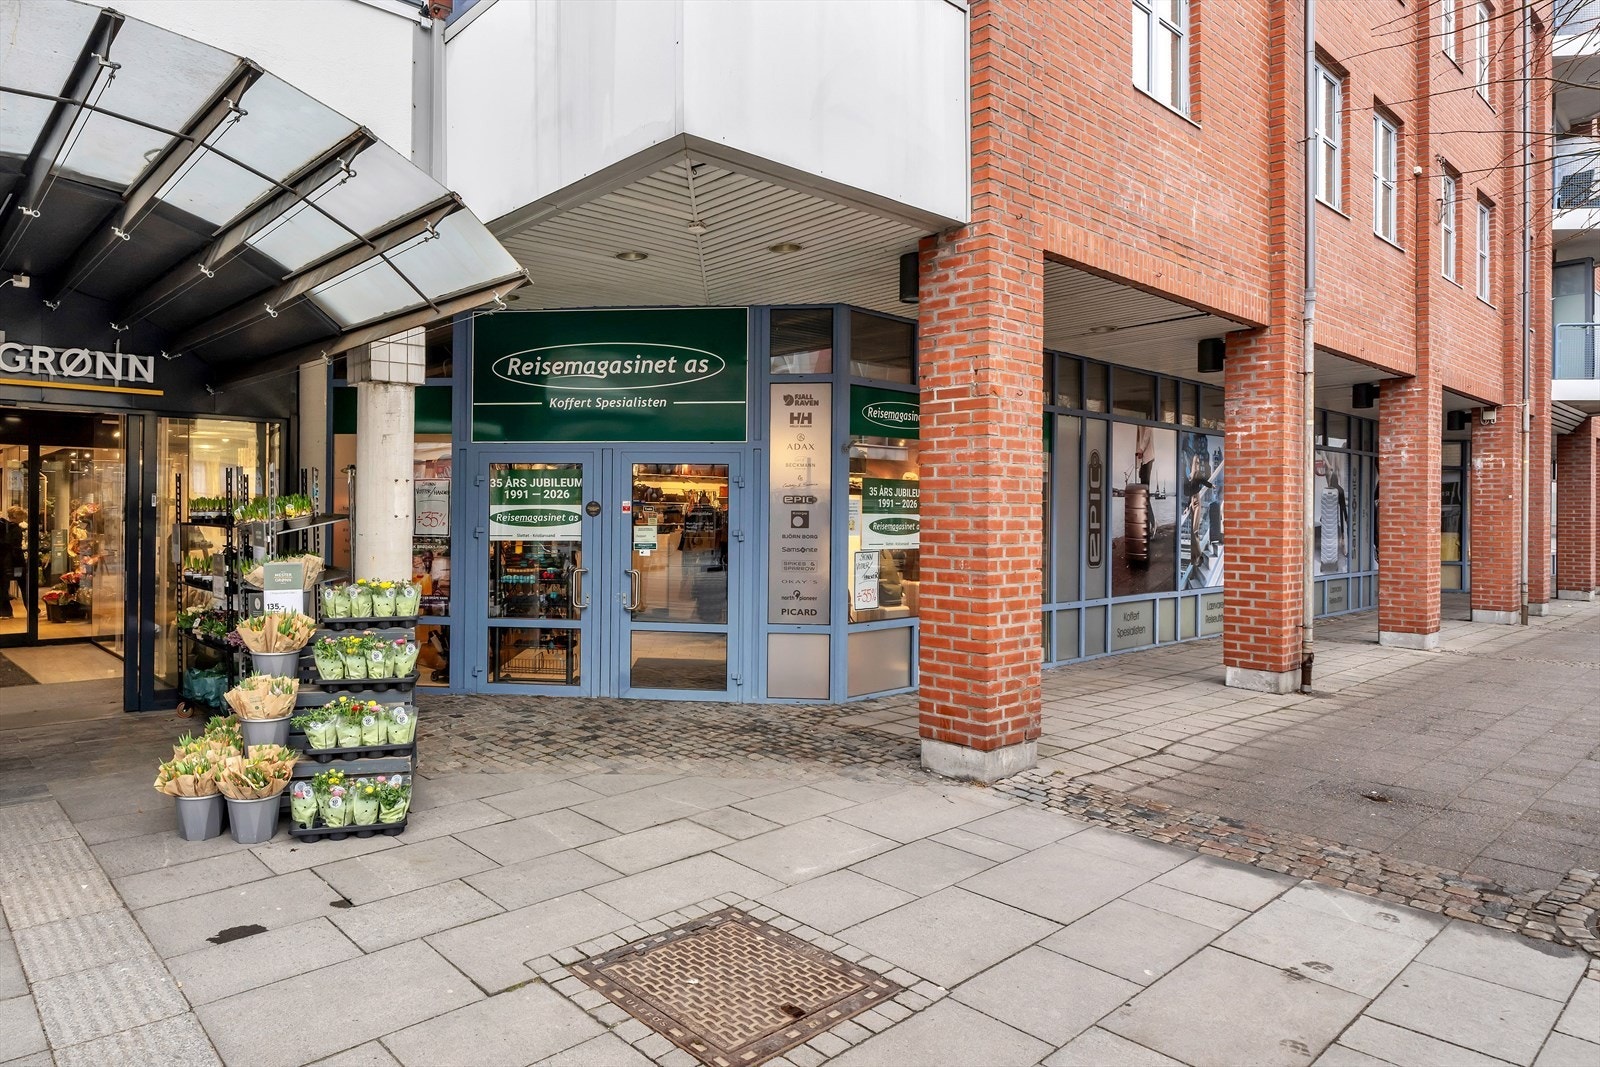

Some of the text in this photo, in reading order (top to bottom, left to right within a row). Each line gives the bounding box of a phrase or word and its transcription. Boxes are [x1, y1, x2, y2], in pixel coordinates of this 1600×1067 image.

[0, 343, 154, 383] GRØNN
[507, 354, 710, 379] Reisemagasinet as
[549, 396, 667, 411] Koffert Spesialisten
[867, 406, 920, 423] Reisemagasin
[786, 443, 815, 451] ADAX
[490, 475, 582, 488] 35 ÅRS JUBILEUM
[504, 489, 529, 499] 1991
[543, 489, 570, 499] 2026
[869, 486, 878, 496] 35
[878, 484, 893, 497] ÅRS
[878, 498, 894, 508] 1991
[901, 499, 918, 509] 2026
[496, 513, 566, 524] Reisemagasinet
[872, 520, 915, 532] Reisemagasinet
[781, 608, 818, 616] PICARD
